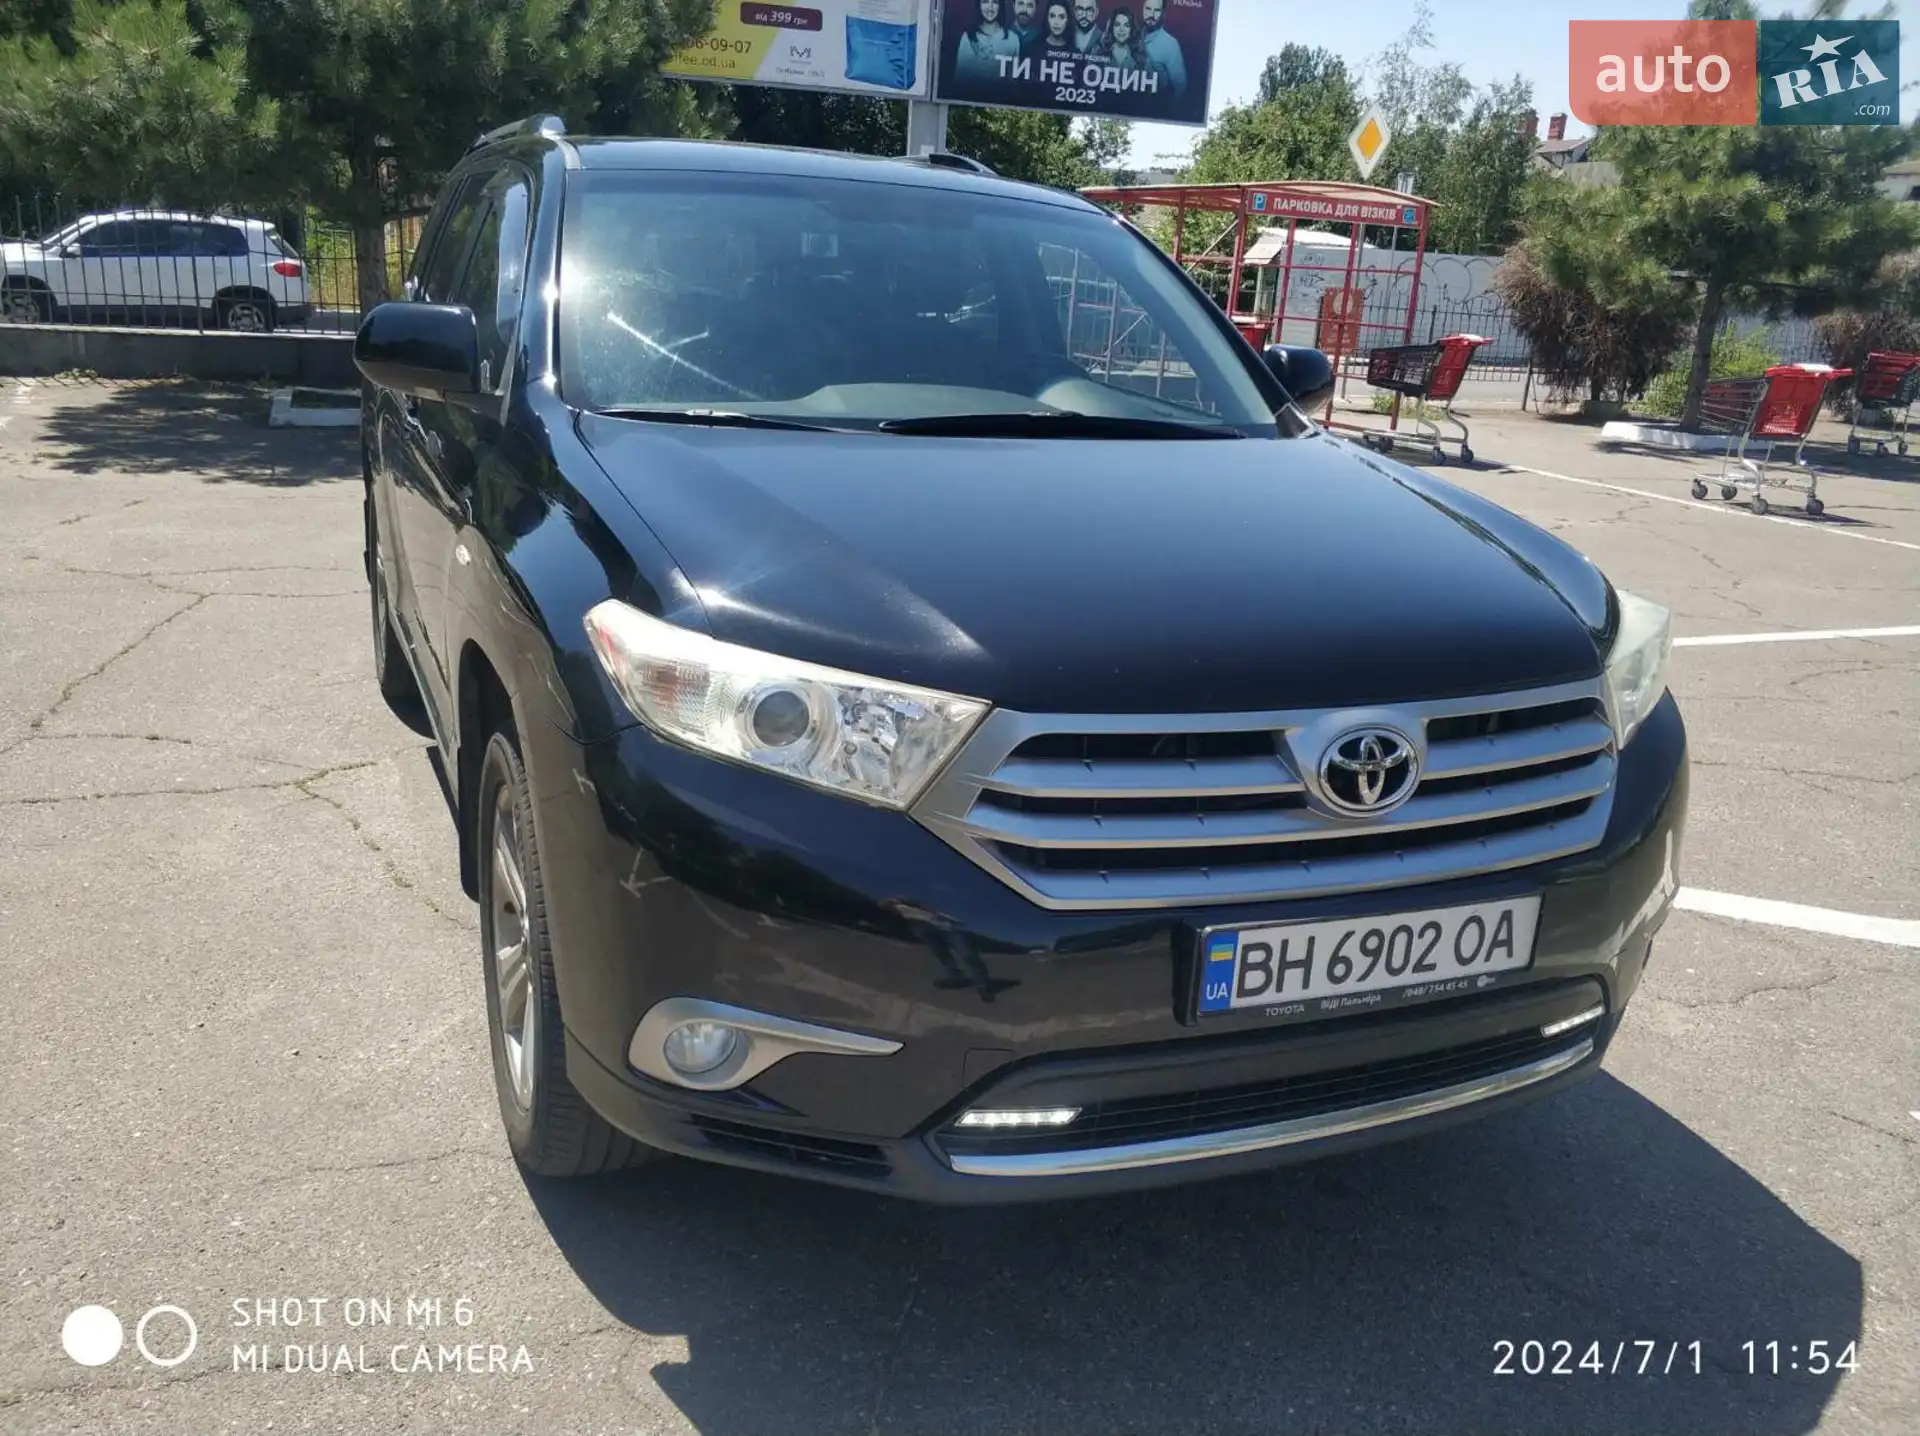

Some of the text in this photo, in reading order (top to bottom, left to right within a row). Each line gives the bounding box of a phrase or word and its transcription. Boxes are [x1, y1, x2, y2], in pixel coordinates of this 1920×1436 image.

[771, 11, 792, 23] 399
[793, 17, 809, 26] грн
[995, 54, 1158, 94] ТИ НЕ ОДИН
[1055, 87, 1096, 104] 2023
[1273, 197, 1396, 220] ПАРКОВКА ДЛЯ ВІЗКІВ
[1236, 909, 1514, 998] BH 6902 OA
[1206, 983, 1228, 1000] UA
[1265, 1004, 1305, 1016] TOYOTA
